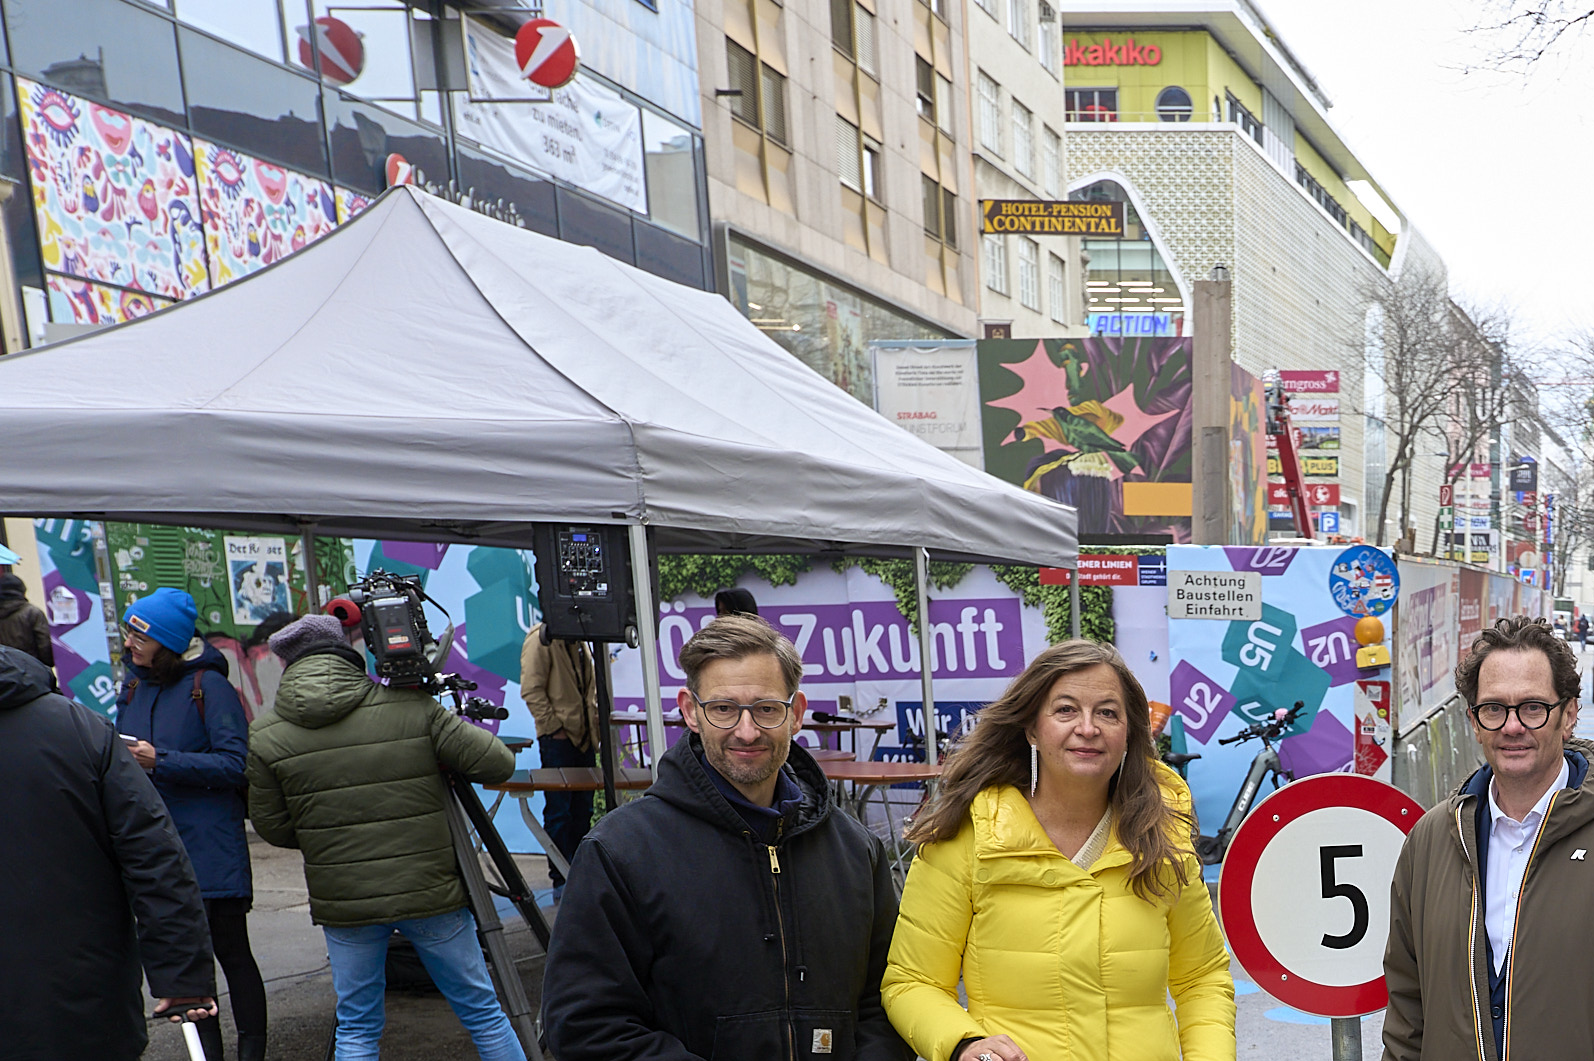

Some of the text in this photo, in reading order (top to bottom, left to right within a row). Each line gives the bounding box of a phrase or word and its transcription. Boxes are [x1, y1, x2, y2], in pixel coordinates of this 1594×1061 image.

[532, 107, 546, 122] zu
[542, 134, 561, 159] 363
[1001, 203, 1112, 217] HOTEL-PENSION
[993, 216, 1121, 233] CONTINENTAL
[1095, 314, 1169, 334] ACTION
[897, 411, 937, 420] STRABAG
[1310, 462, 1334, 471] PLUS
[1323, 517, 1336, 531] P
[1077, 560, 1132, 569] ENER LINIEN
[1250, 547, 1292, 568] U2
[1184, 574, 1246, 589] Achtung
[1177, 588, 1253, 602] Baustellen
[1186, 603, 1244, 617] Einfahrt
[779, 606, 1007, 677] Zukunft
[1239, 620, 1283, 672] U5
[1308, 631, 1351, 668] U2
[1174, 682, 1223, 730] U2
[905, 707, 952, 736] Wir
[1319, 843, 1370, 950] 5
